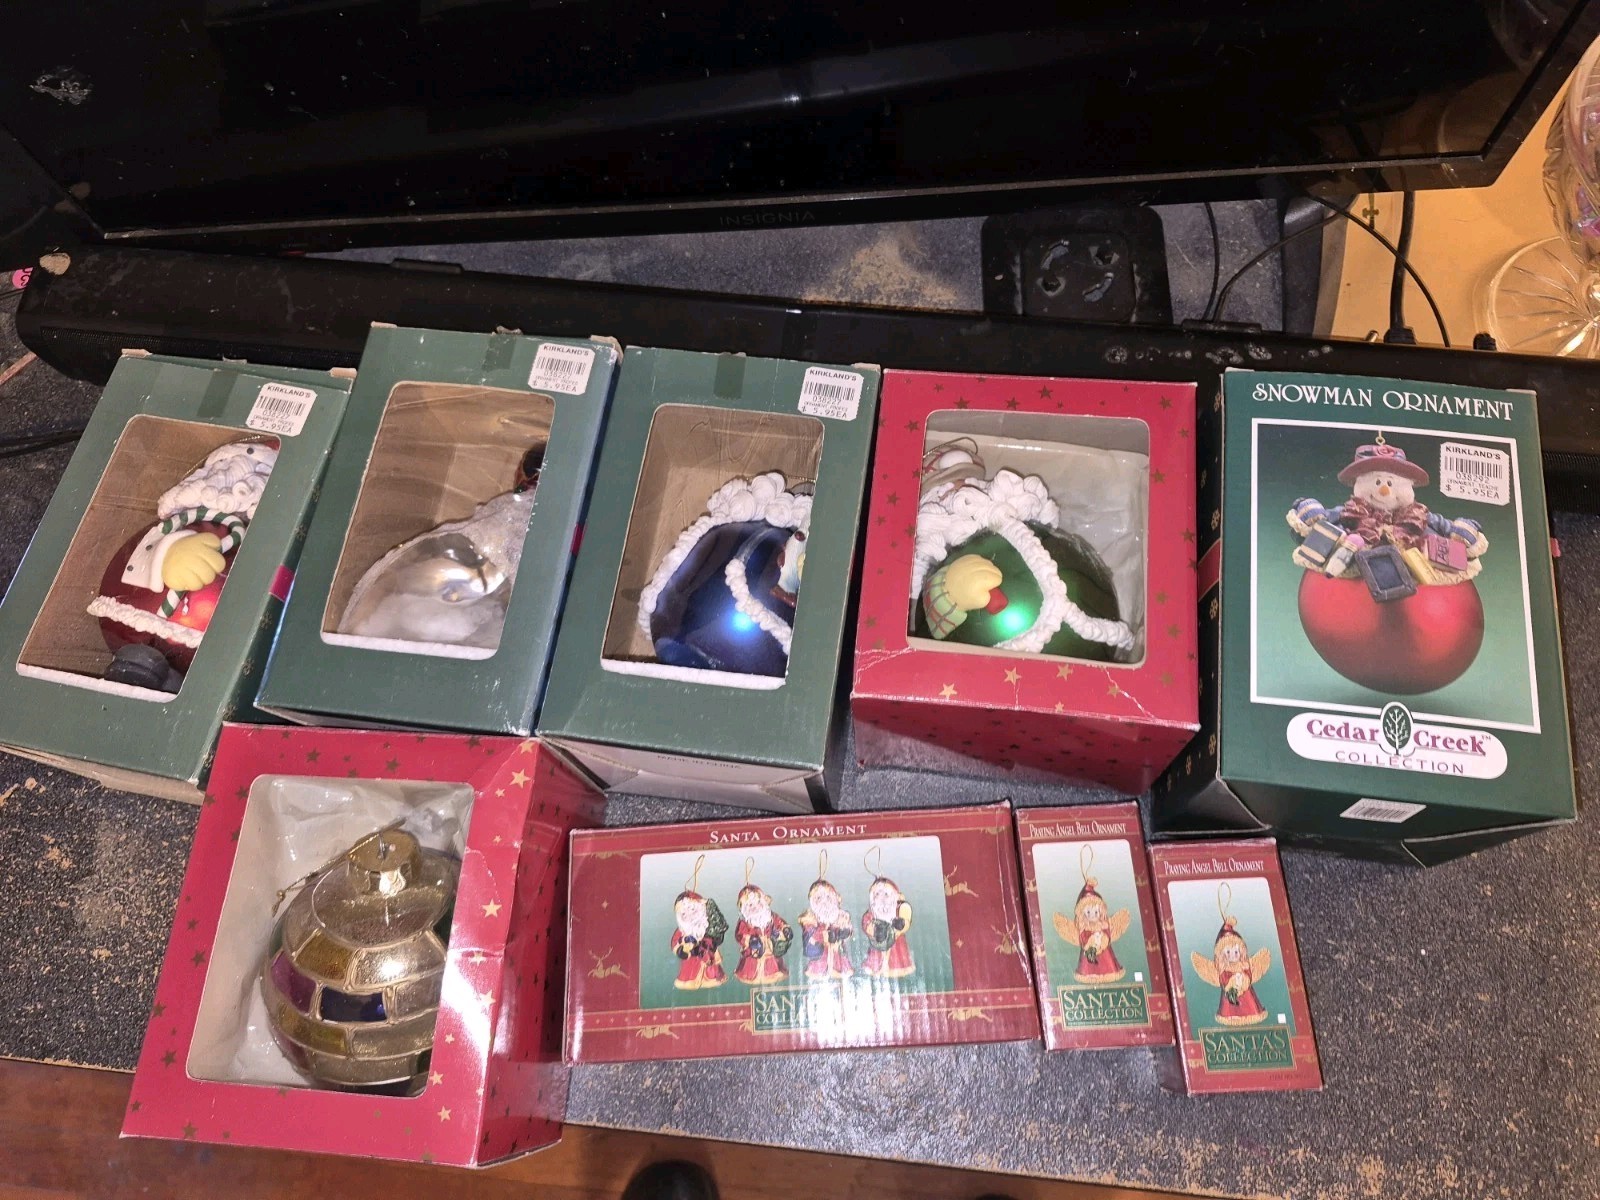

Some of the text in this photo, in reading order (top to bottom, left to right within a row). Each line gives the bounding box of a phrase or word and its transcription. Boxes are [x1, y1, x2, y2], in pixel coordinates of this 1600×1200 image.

[719, 210, 816, 226] INSIGNIA
[543, 345, 589, 356] KIRKLAND'S
[809, 369, 857, 381] KIRKLAND'S
[267, 385, 312, 398] KIRKLAND'S
[1252, 383, 1514, 421] SNOWMAN ORNAMENT
[1445, 446, 1501, 460] KIRKLAND'S
[1455, 472, 1490, 484] 038292
[1306, 718, 1380, 742] Cedar
[1335, 750, 1465, 774] COLLECTION
[709, 824, 868, 844] SANTA ORNAMENT
[1029, 820, 1127, 838] PRAYING ANGEL BELL ORNAMENT
[1163, 857, 1264, 876] PRAYING ANGEL BELL ORNAMENT
[1063, 988, 1142, 1011] SANTA'S
[1065, 1007, 1143, 1021] COLLECTION
[1205, 1029, 1286, 1055] SANTA'S
[1207, 1051, 1287, 1064] COLLECTION
